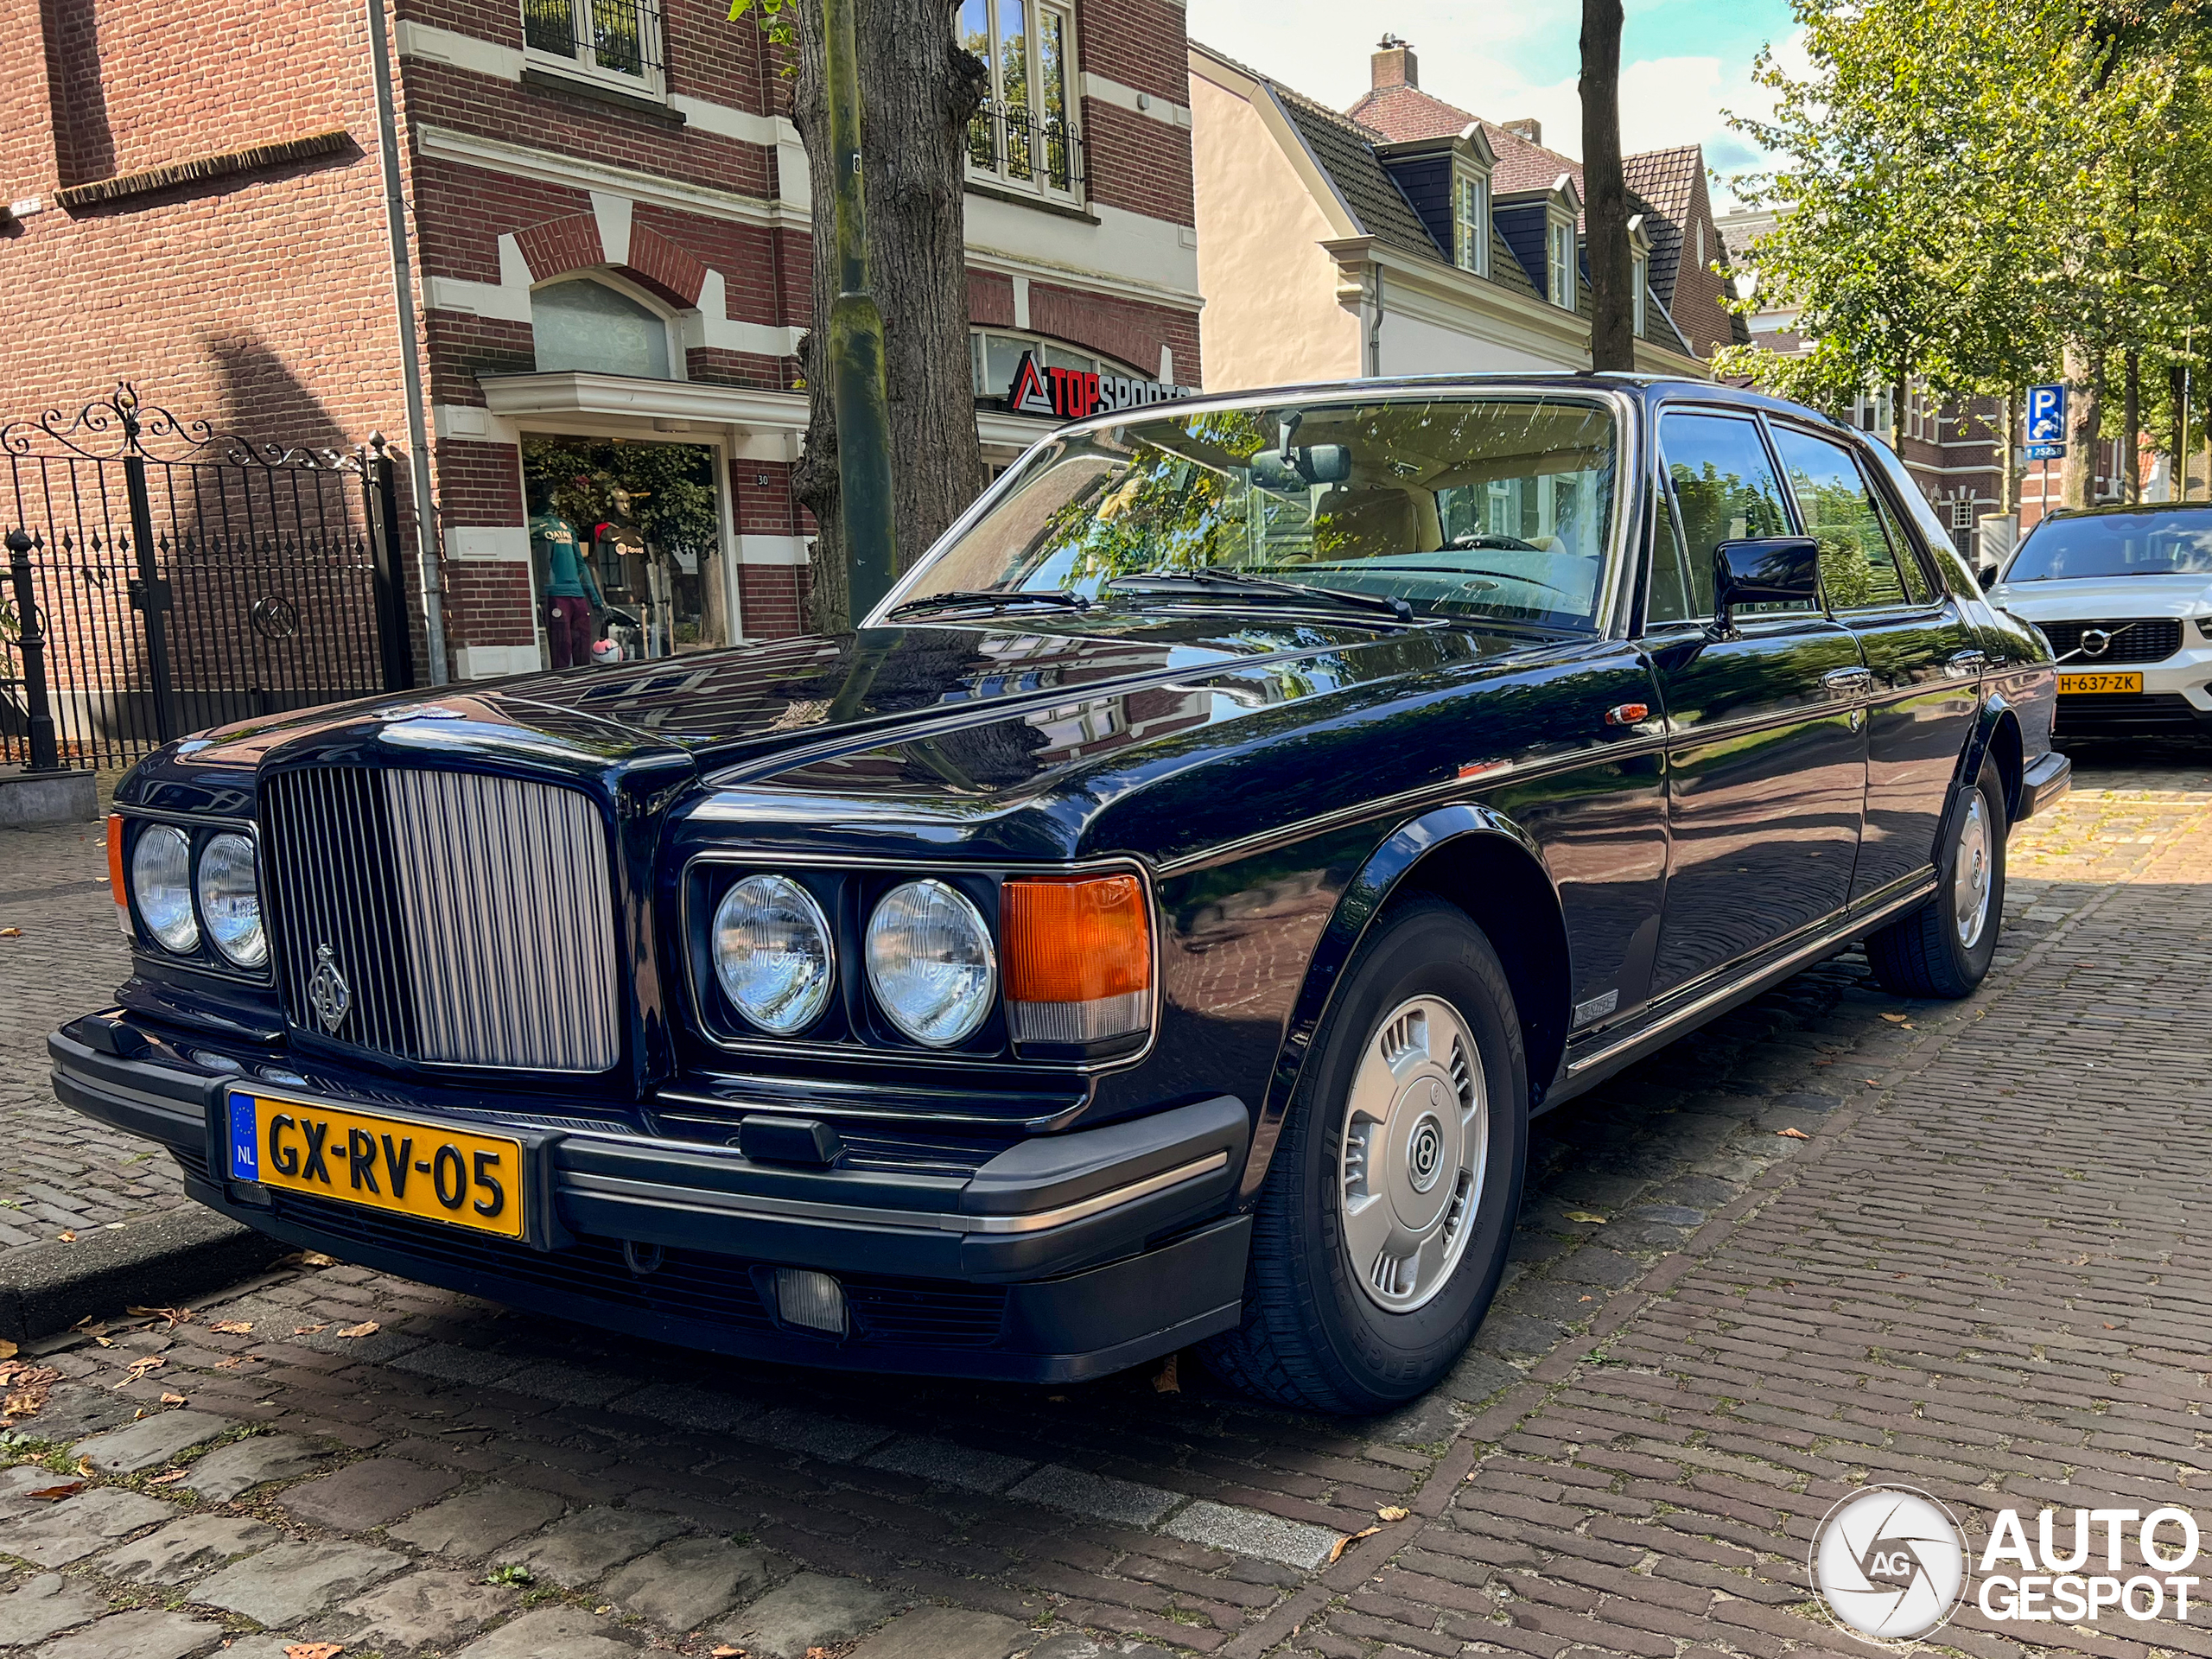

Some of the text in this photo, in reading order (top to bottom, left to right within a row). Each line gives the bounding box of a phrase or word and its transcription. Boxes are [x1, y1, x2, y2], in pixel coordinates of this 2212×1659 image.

[1050, 366, 1191, 417] TOPSPO
[2035, 389, 2056, 419] P
[758, 474, 768, 486] 30
[2061, 676, 2134, 691] H-637-ZK
[237, 1144, 256, 1166] NL
[268, 1113, 505, 1217] GX-RV-05
